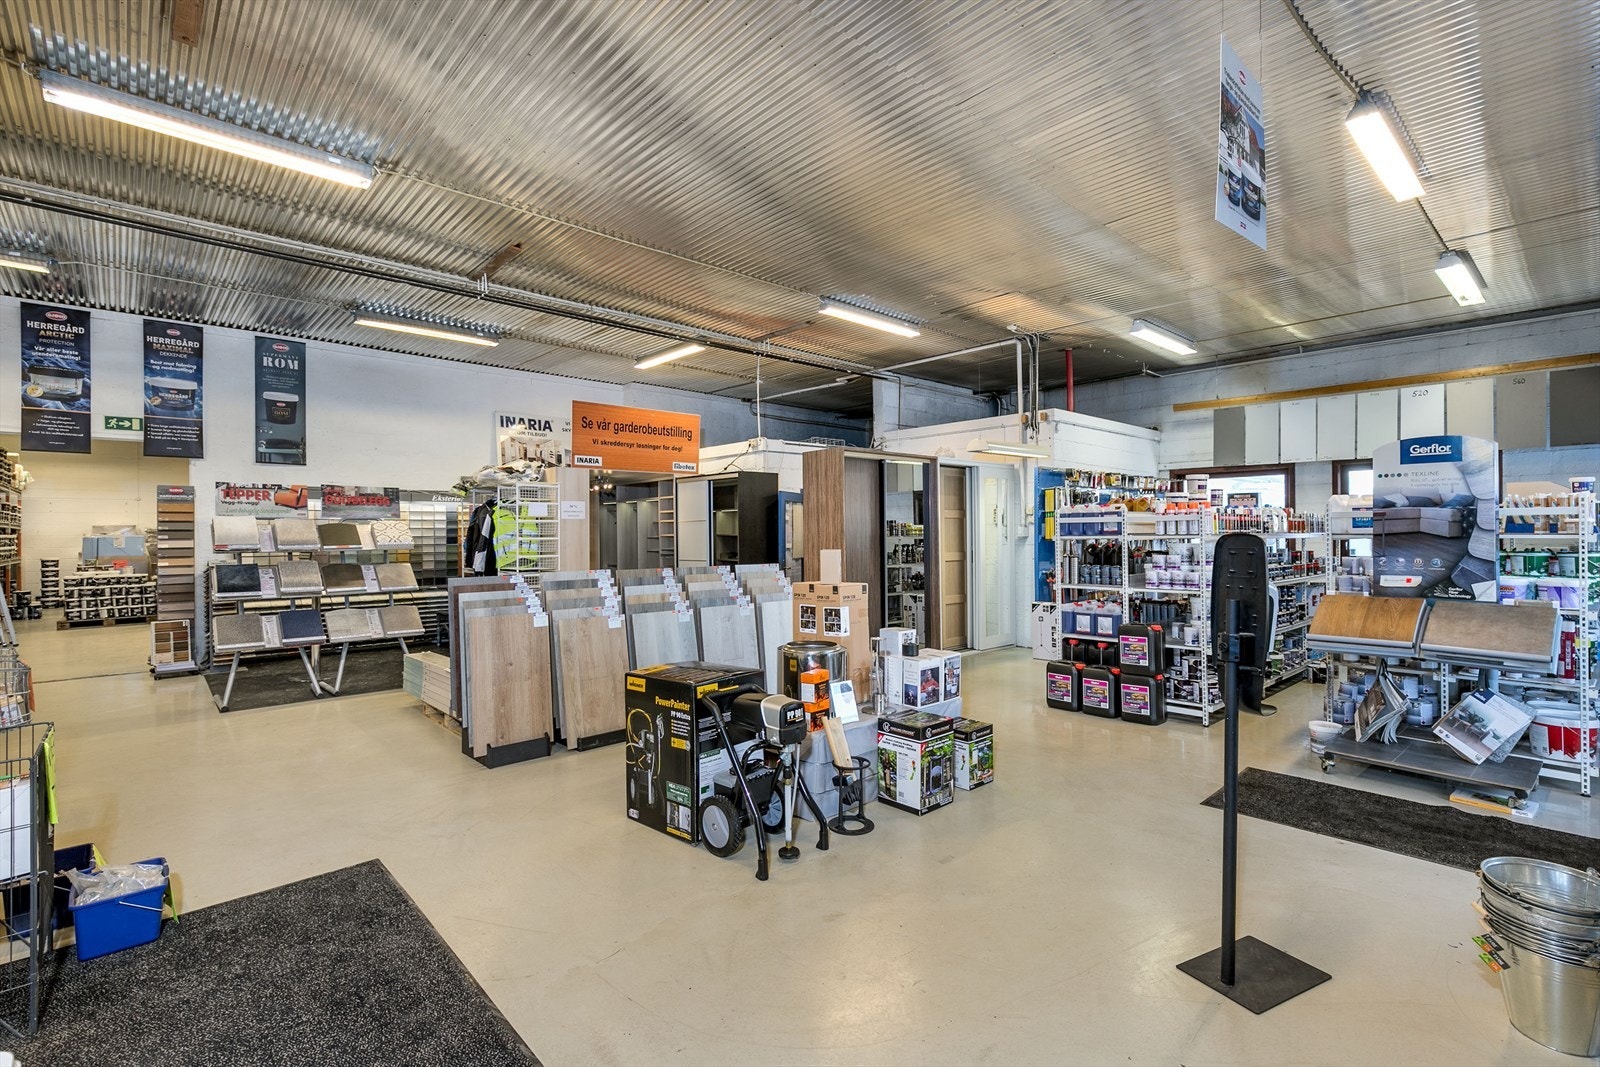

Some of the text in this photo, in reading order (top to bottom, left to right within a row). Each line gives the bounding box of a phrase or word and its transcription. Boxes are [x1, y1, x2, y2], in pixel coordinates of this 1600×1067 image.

[26, 320, 85, 334] HERREGÅRD
[39, 330, 75, 339] ARCTIC
[39, 338, 75, 346] PROTECTION
[146, 336, 200, 348] HERREGÅRD
[152, 343, 194, 354] MAXIMAL
[160, 351, 188, 359] DEKKENDE
[262, 356, 299, 370] ROM
[1412, 389, 1429, 398] 520
[500, 415, 553, 432] INARIA
[581, 416, 693, 442] Se vår garderobeutstilling
[600, 440, 635, 449] skreddersyr
[1409, 443, 1452, 454] Gerflor
[576, 456, 600, 465] INARIA
[221, 488, 272, 502] TEPPER
[655, 695, 691, 711] PowerPainter
[786, 711, 794, 720] PP
